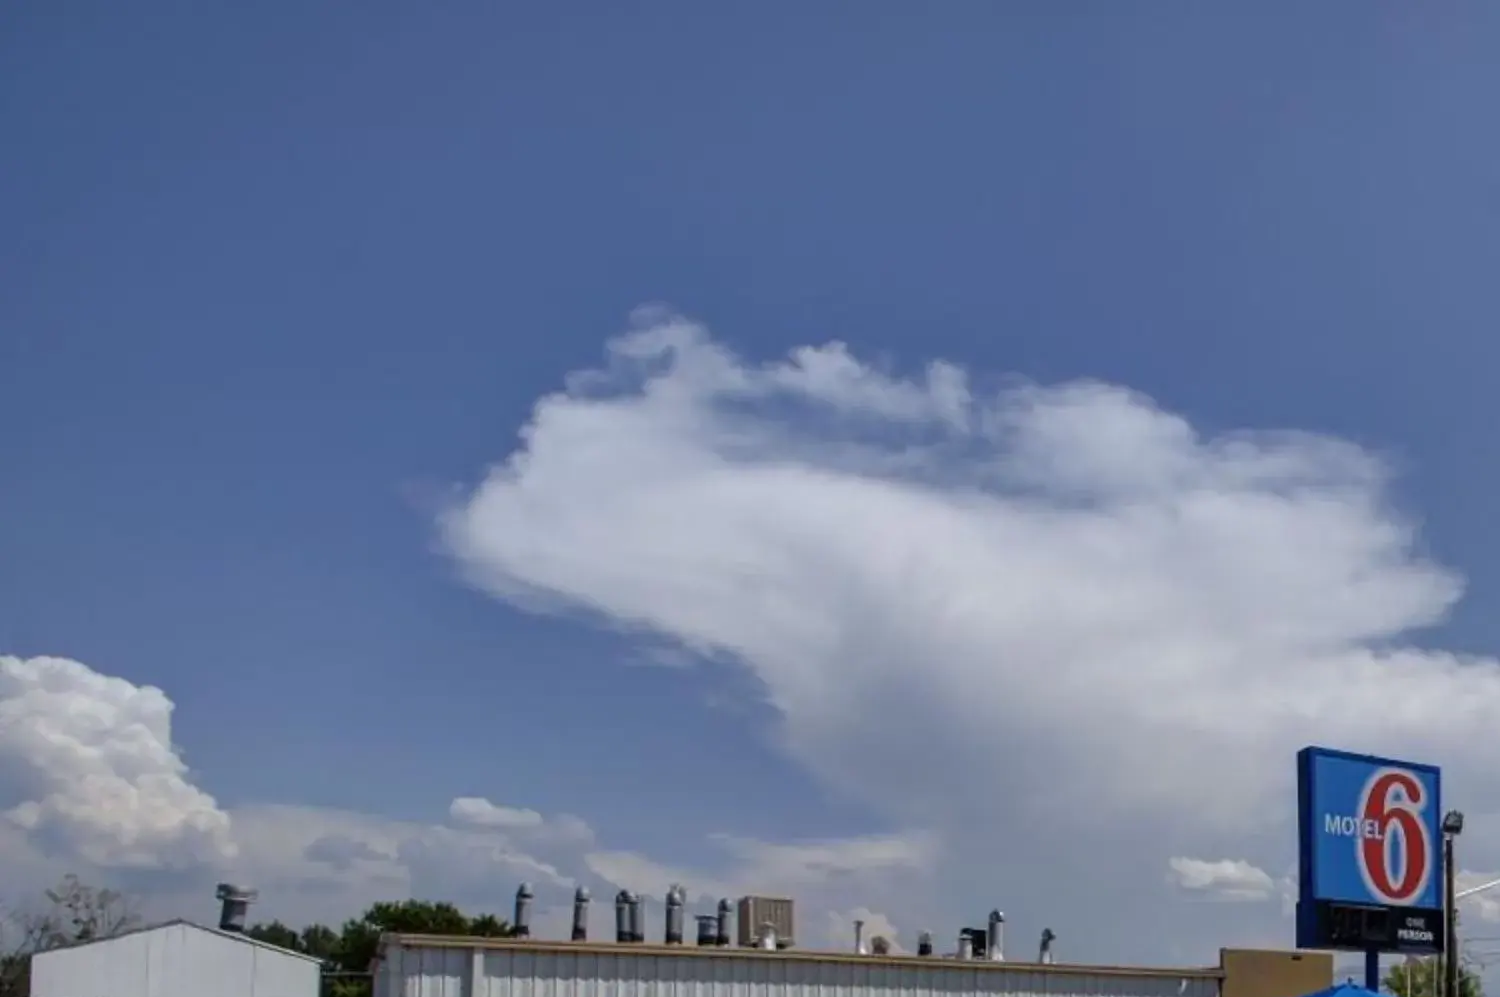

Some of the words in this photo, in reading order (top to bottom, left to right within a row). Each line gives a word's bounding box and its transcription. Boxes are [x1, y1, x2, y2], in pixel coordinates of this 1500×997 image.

[1324, 812, 1385, 840] MOTEL
[1360, 769, 1428, 903] 6
[1397, 928, 1434, 941] PERSON
